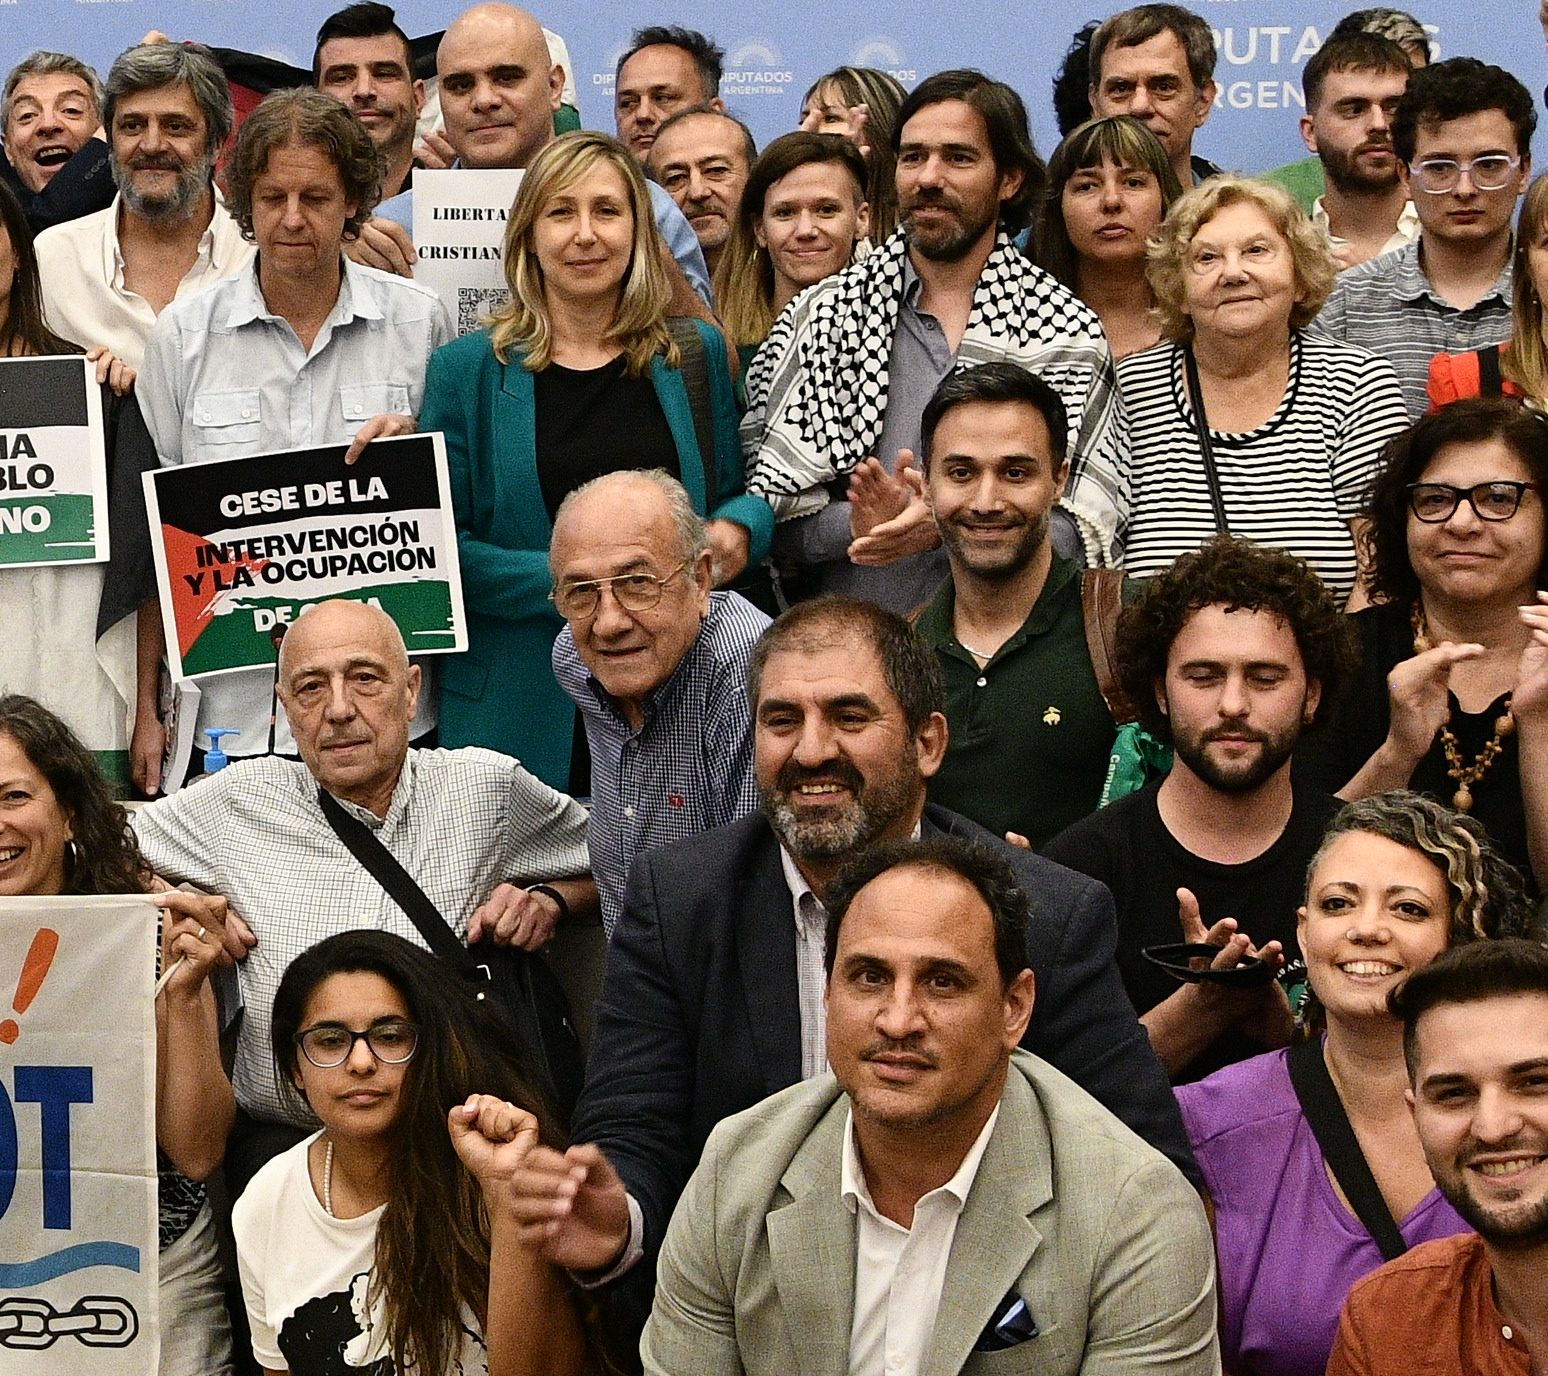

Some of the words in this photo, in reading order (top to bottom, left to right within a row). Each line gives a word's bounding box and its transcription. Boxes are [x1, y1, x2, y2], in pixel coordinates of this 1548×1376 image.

[723, 85, 783, 95] ARGENTINA
[433, 207, 511, 221] LIBERTA
[418, 245, 502, 260] CRISTIAN
[220, 486, 298, 518] CESE
[304, 480, 344, 508] DE
[349, 476, 389, 502] LA
[196, 516, 420, 568] INTERVENCIÓN
[183, 573, 207, 596] Y
[212, 567, 256, 591] LA
[260, 541, 436, 585] OCUPACIÓN
[253, 606, 292, 633] DE
